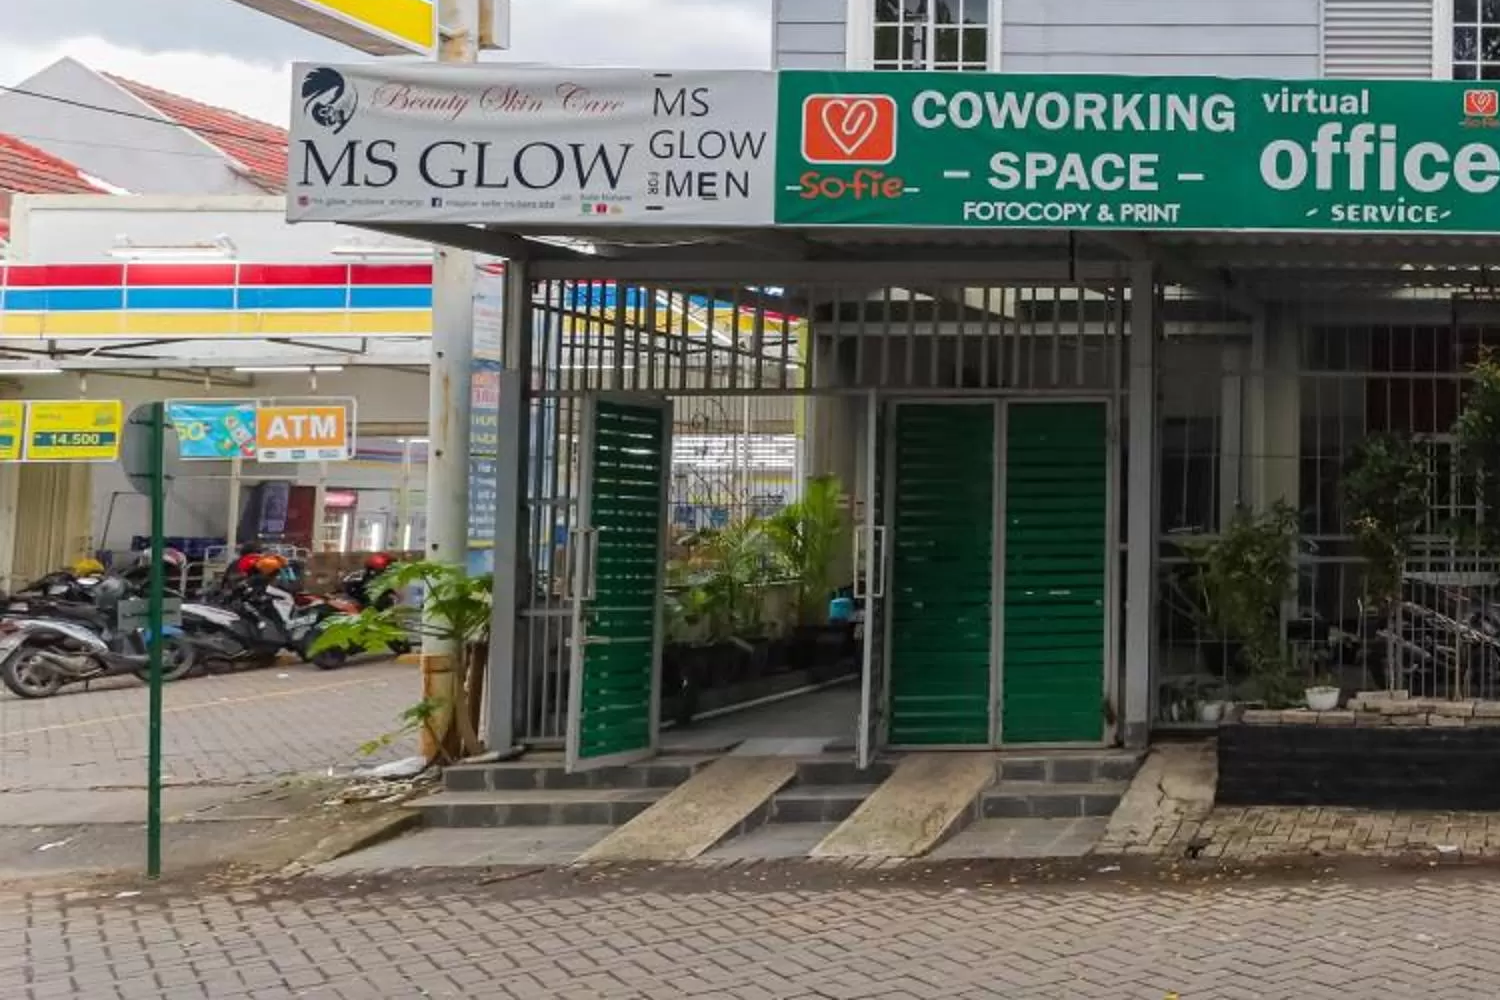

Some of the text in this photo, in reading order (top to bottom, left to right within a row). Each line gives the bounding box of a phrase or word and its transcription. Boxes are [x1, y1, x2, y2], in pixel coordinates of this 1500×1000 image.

[371, 82, 470, 120] Beauty
[480, 86, 543, 113] Skin
[555, 81, 625, 113] Care
[652, 87, 710, 117] MS
[911, 90, 1237, 132] COWORKING
[1262, 88, 1369, 115] virtual
[649, 130, 767, 159] GLOW
[1259, 121, 1500, 194] office
[297, 138, 634, 190] MS GLOW
[987, 151, 1160, 192] SPACE
[647, 170, 749, 199] FOR MEN
[800, 169, 904, 200] Sofie
[963, 201, 1181, 223] FOTOCOPY & PRINT
[51, 432, 99, 445] 14.500
[267, 414, 337, 440] ATM
